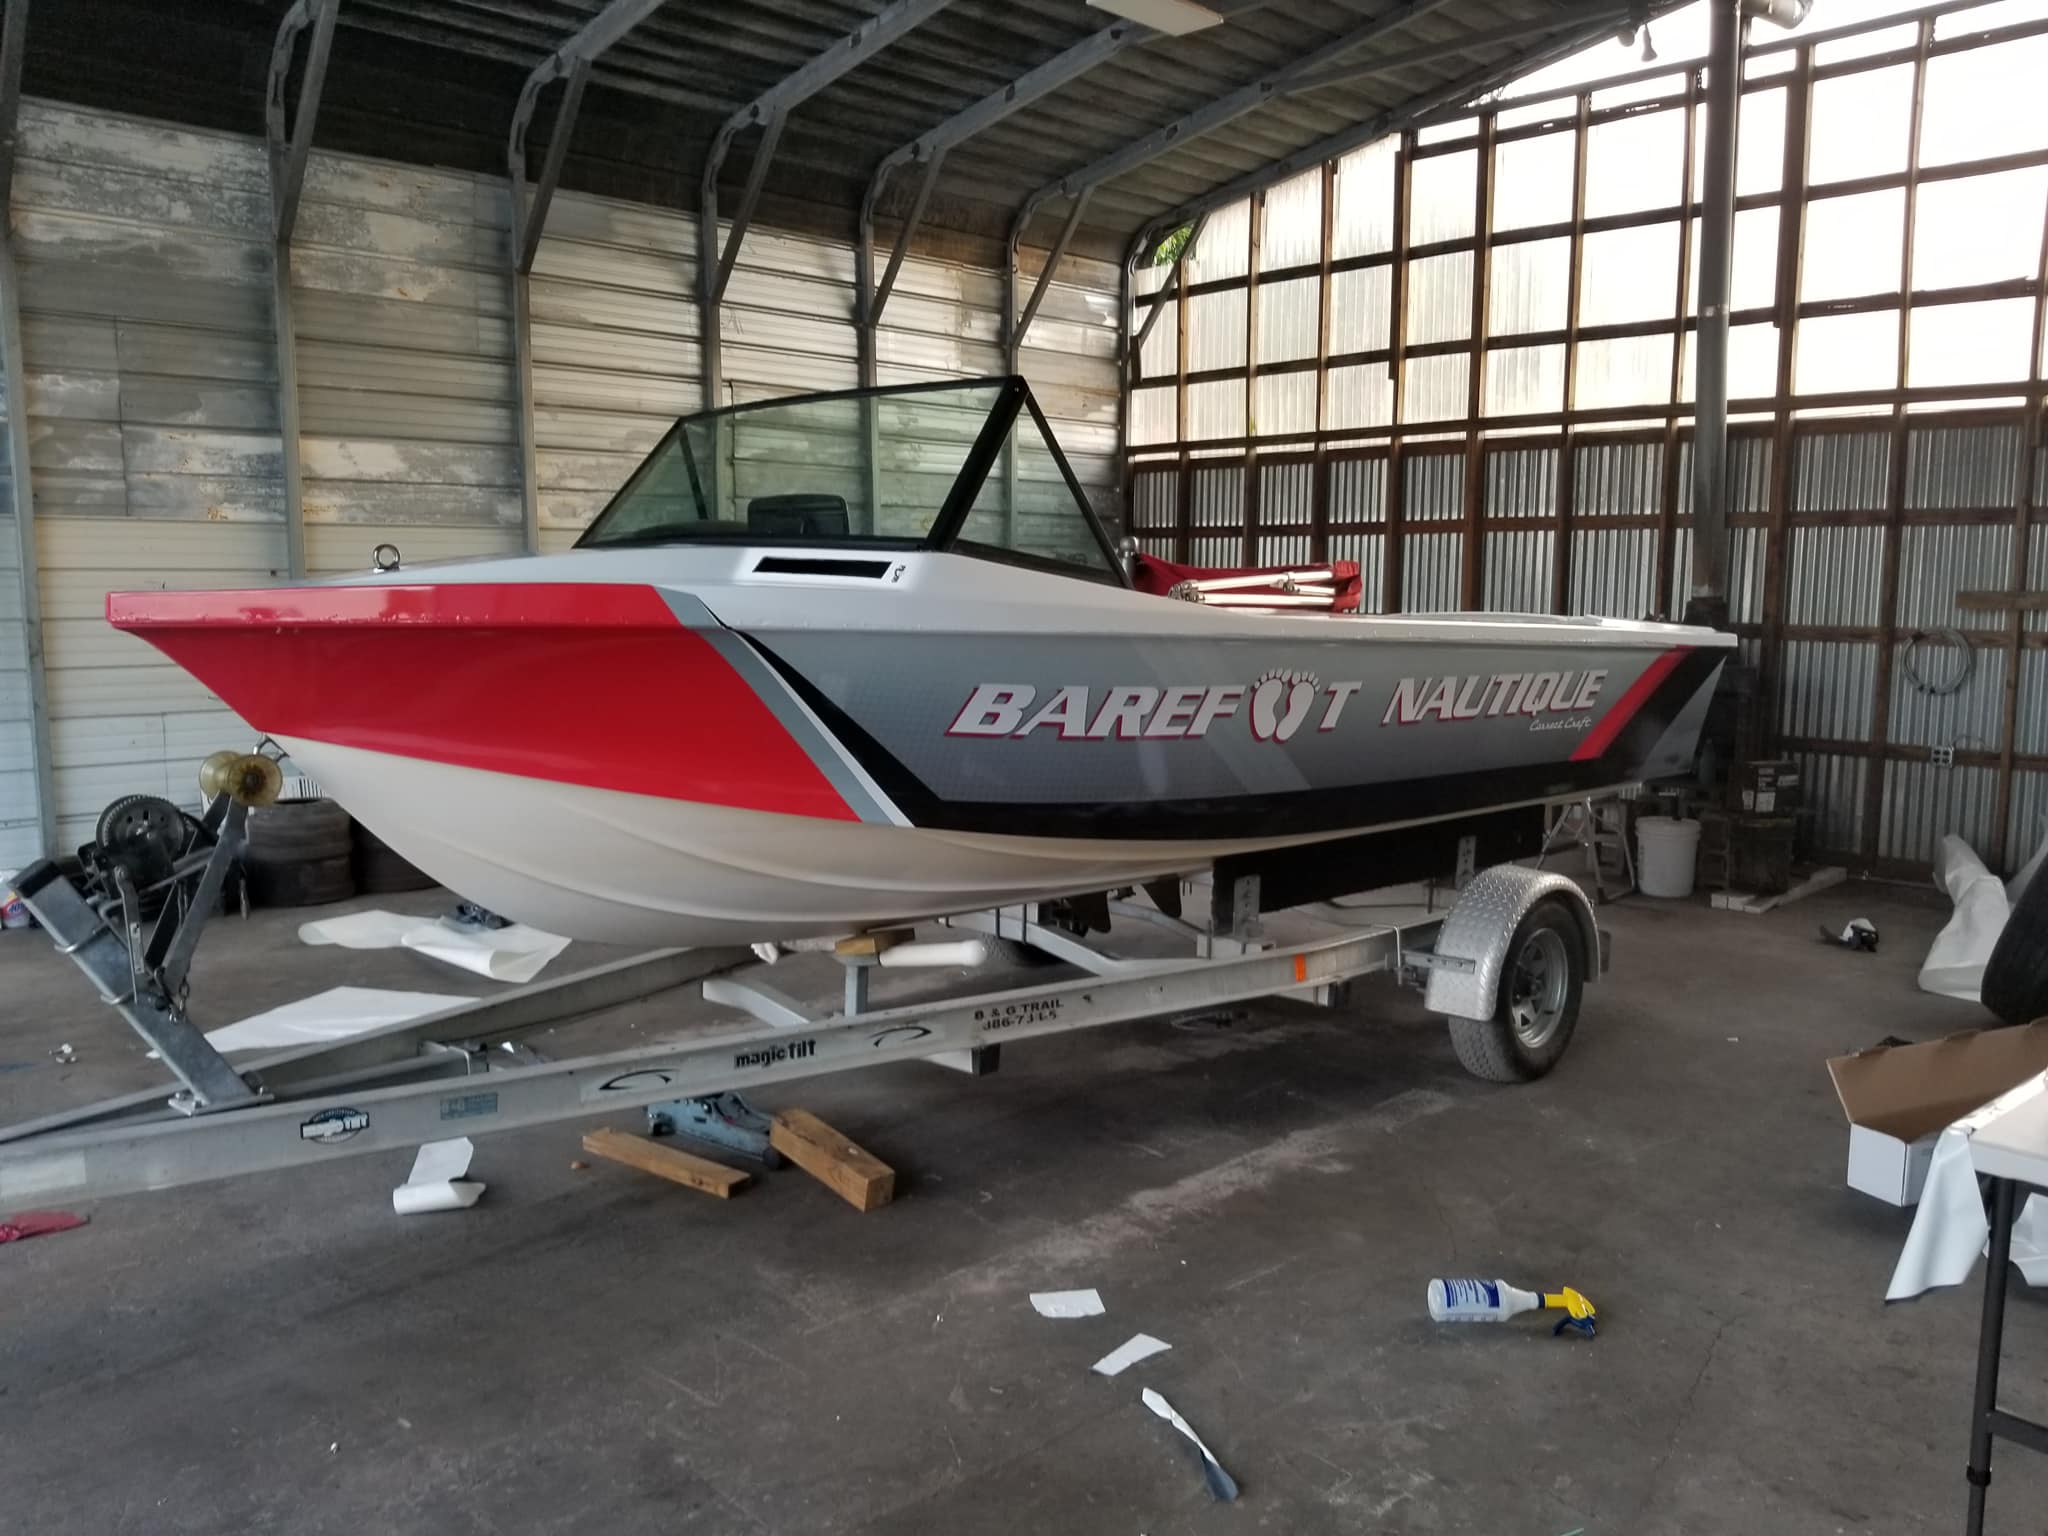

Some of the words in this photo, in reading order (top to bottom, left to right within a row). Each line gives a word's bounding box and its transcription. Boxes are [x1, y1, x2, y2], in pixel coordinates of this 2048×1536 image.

[1379, 669, 1609, 727] NAUTIQUE
[1020, 999, 1064, 1014] TRAIL
[735, 1044, 786, 1069] magic
